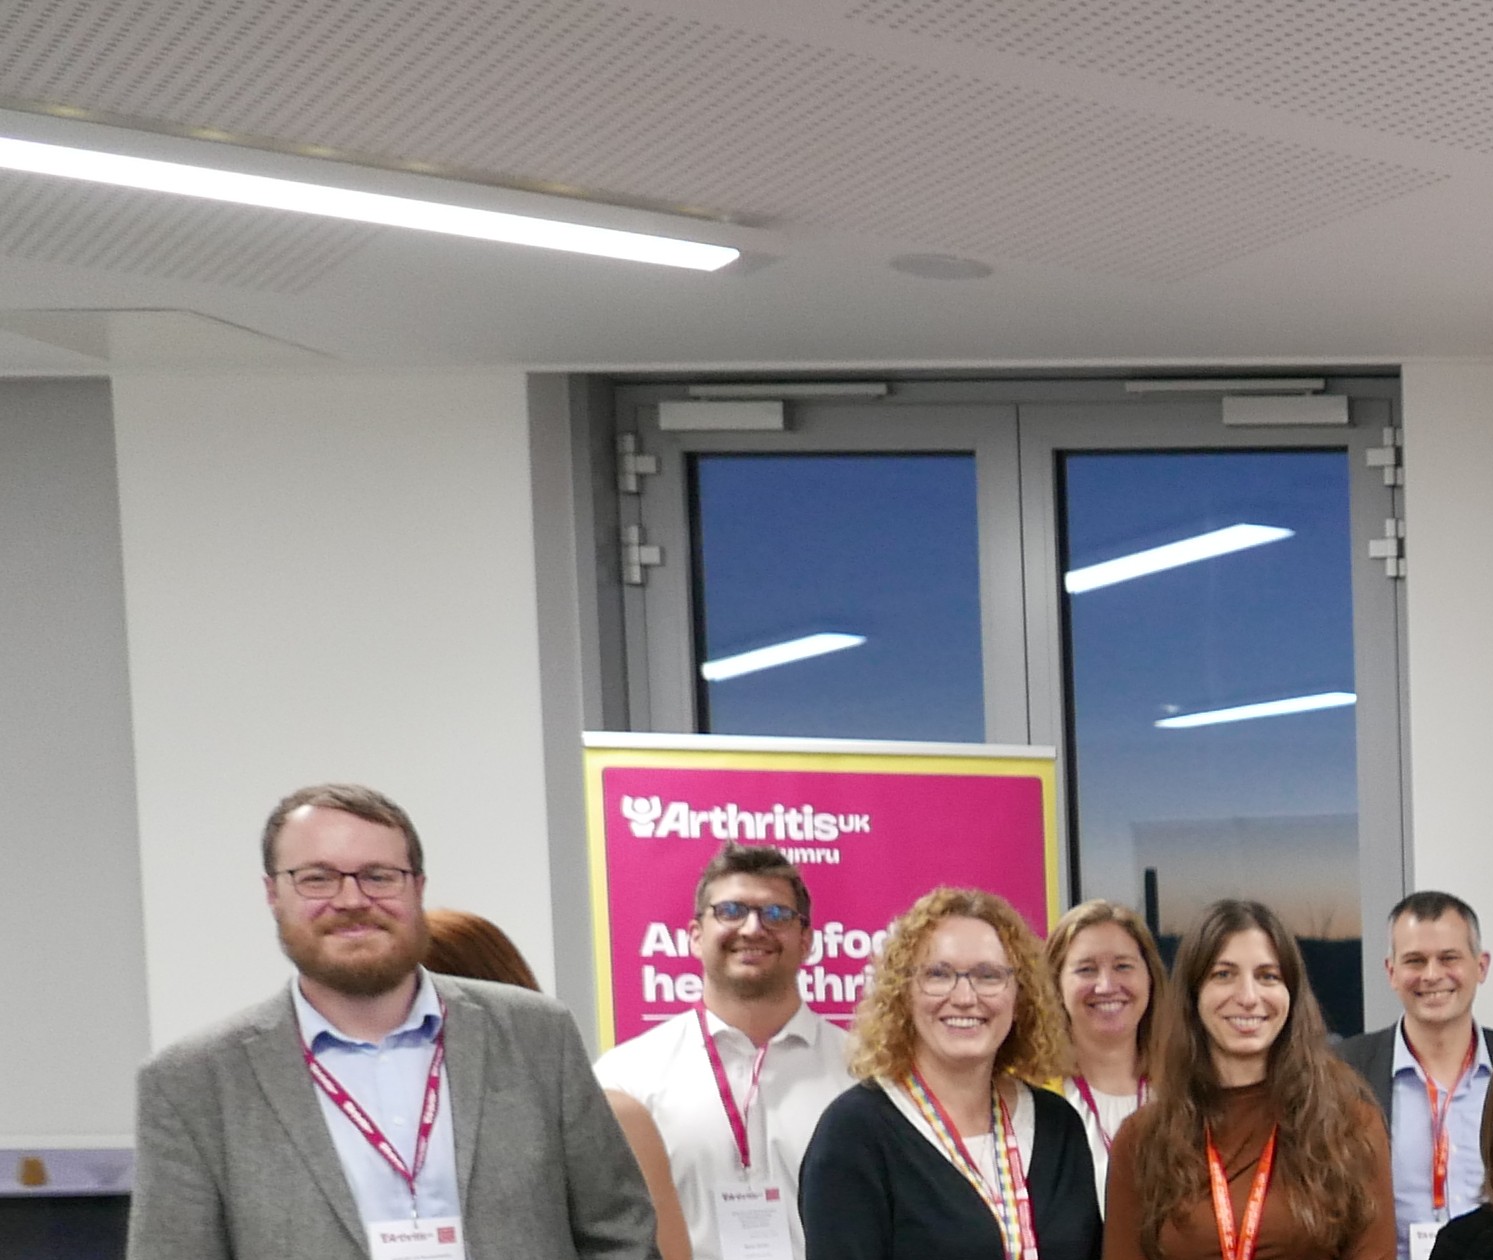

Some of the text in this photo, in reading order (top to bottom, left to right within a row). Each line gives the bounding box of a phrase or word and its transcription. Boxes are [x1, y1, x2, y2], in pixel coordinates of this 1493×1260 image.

[654, 802, 870, 841] Arthritis UK
[780, 847, 840, 864] ymru
[643, 965, 703, 1003] he
